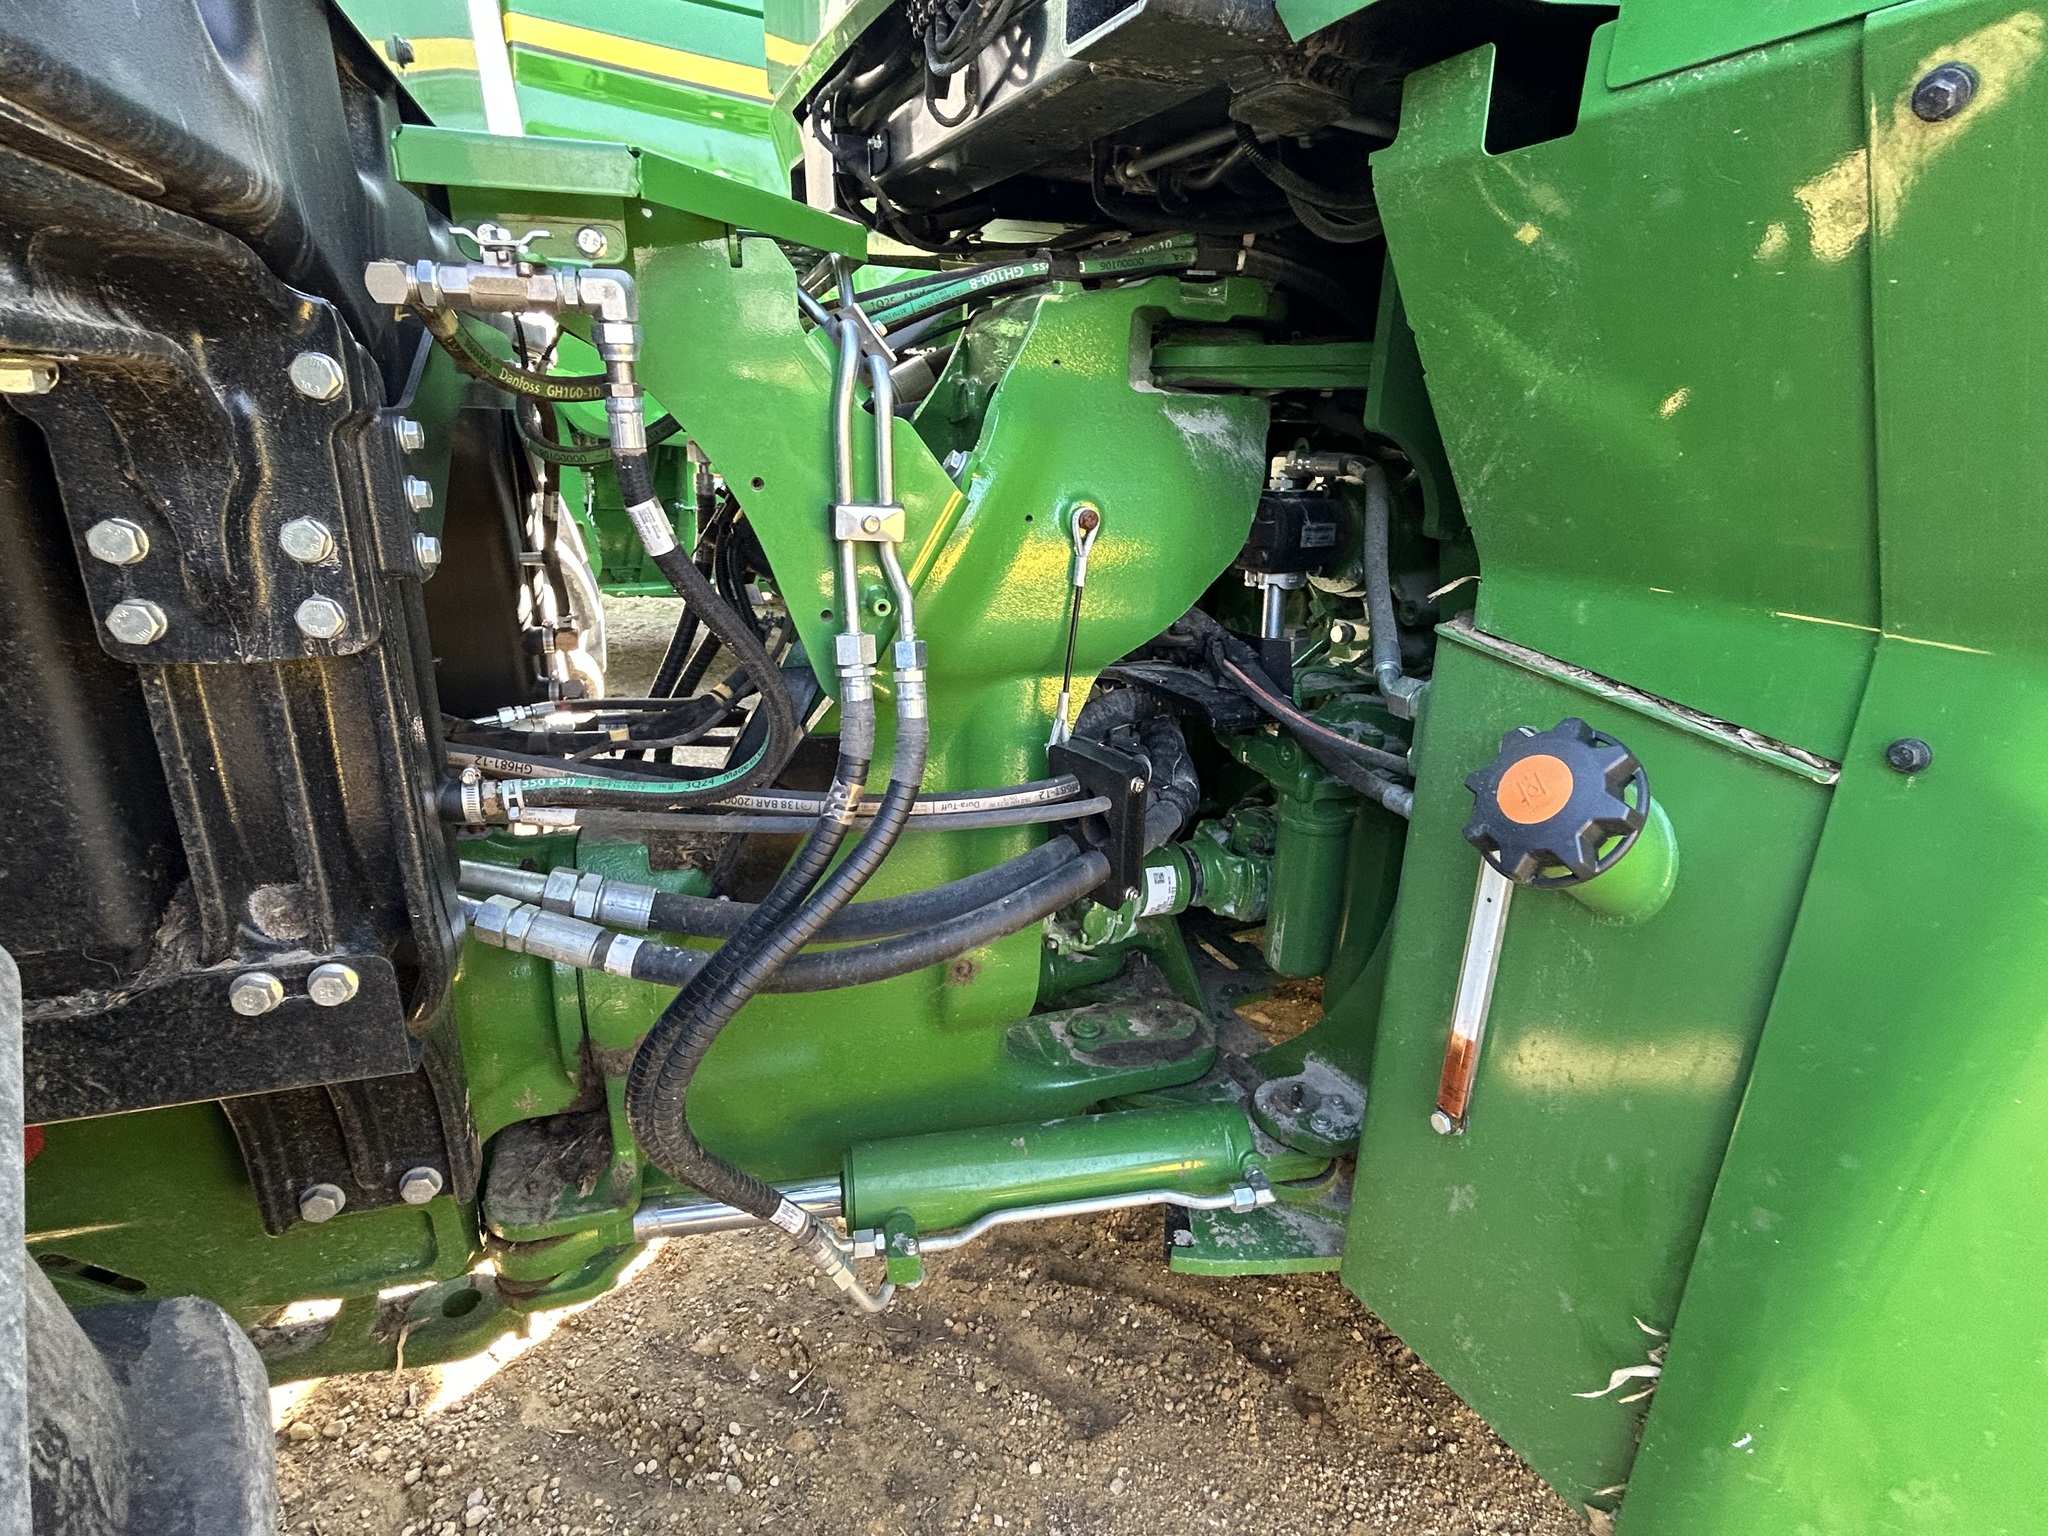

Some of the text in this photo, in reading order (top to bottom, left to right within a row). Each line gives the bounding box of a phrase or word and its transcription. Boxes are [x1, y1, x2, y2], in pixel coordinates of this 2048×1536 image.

[968, 265, 1025, 290] GH100-8
[499, 367, 601, 398] Danfoss GH100-10
[475, 755, 533, 775] GH681-12
[549, 777, 576, 787] PSI)
[684, 778, 715, 790] 3Q24
[756, 799, 778, 809] BAR
[781, 800, 800, 811] 138
[941, 801, 980, 811] Dura-Tuff
